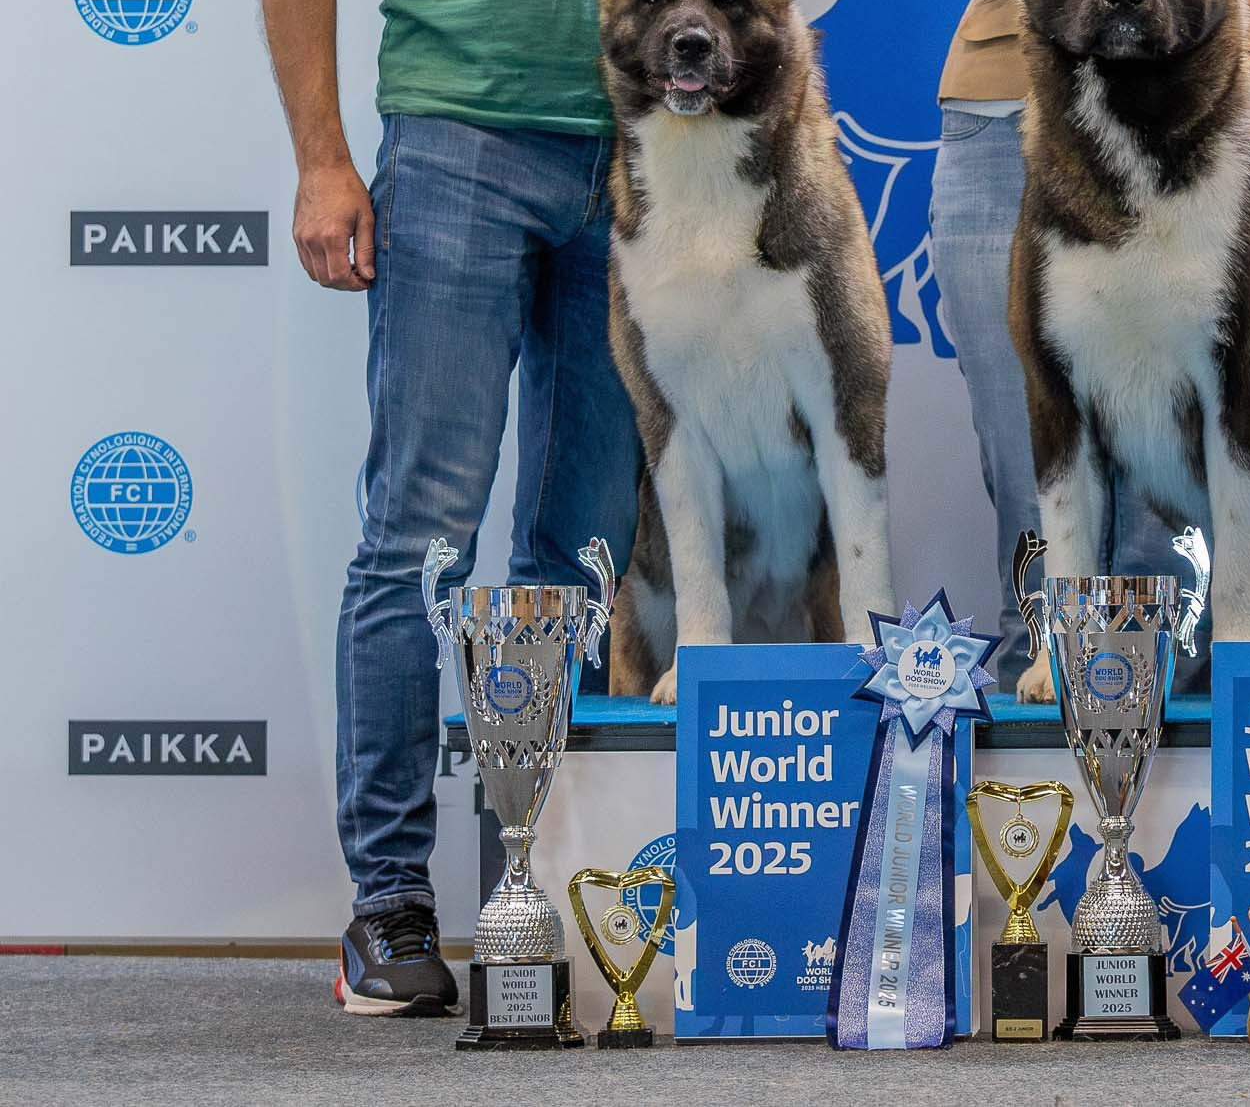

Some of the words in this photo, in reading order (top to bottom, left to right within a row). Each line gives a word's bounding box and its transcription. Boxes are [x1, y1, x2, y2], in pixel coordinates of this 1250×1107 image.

[83, 223, 256, 253] PAIKKA
[79, 435, 163, 473] CYNOLOGIQUE
[149, 448, 190, 547] INTERNATIONALE
[110, 484, 153, 502] FCI
[914, 669, 940, 677] WORLD
[709, 700, 839, 737] Junior
[81, 733, 254, 763] PAIKKA
[709, 745, 832, 782] World
[709, 792, 859, 829] Winner
[895, 785, 917, 843] WORLD
[709, 842, 812, 875] 2025
[888, 847, 911, 906] JUNIOR
[880, 908, 905, 971] WINNER
[502, 969, 536, 977] JUNIOR
[1096, 960, 1136, 969] JUNIOR
[502, 981, 536, 989] WORLD
[1096, 974, 1136, 984] WORLD
[501, 992, 538, 1000] WINNER
[878, 975, 898, 1008] 2025
[1095, 989, 1138, 998] WINNER
[490, 1015, 513, 1023] BEST
[516, 1014, 550, 1022] JUNIOR
[506, 1003, 532, 1011] 2025
[1102, 1004, 1132, 1013] 2025
